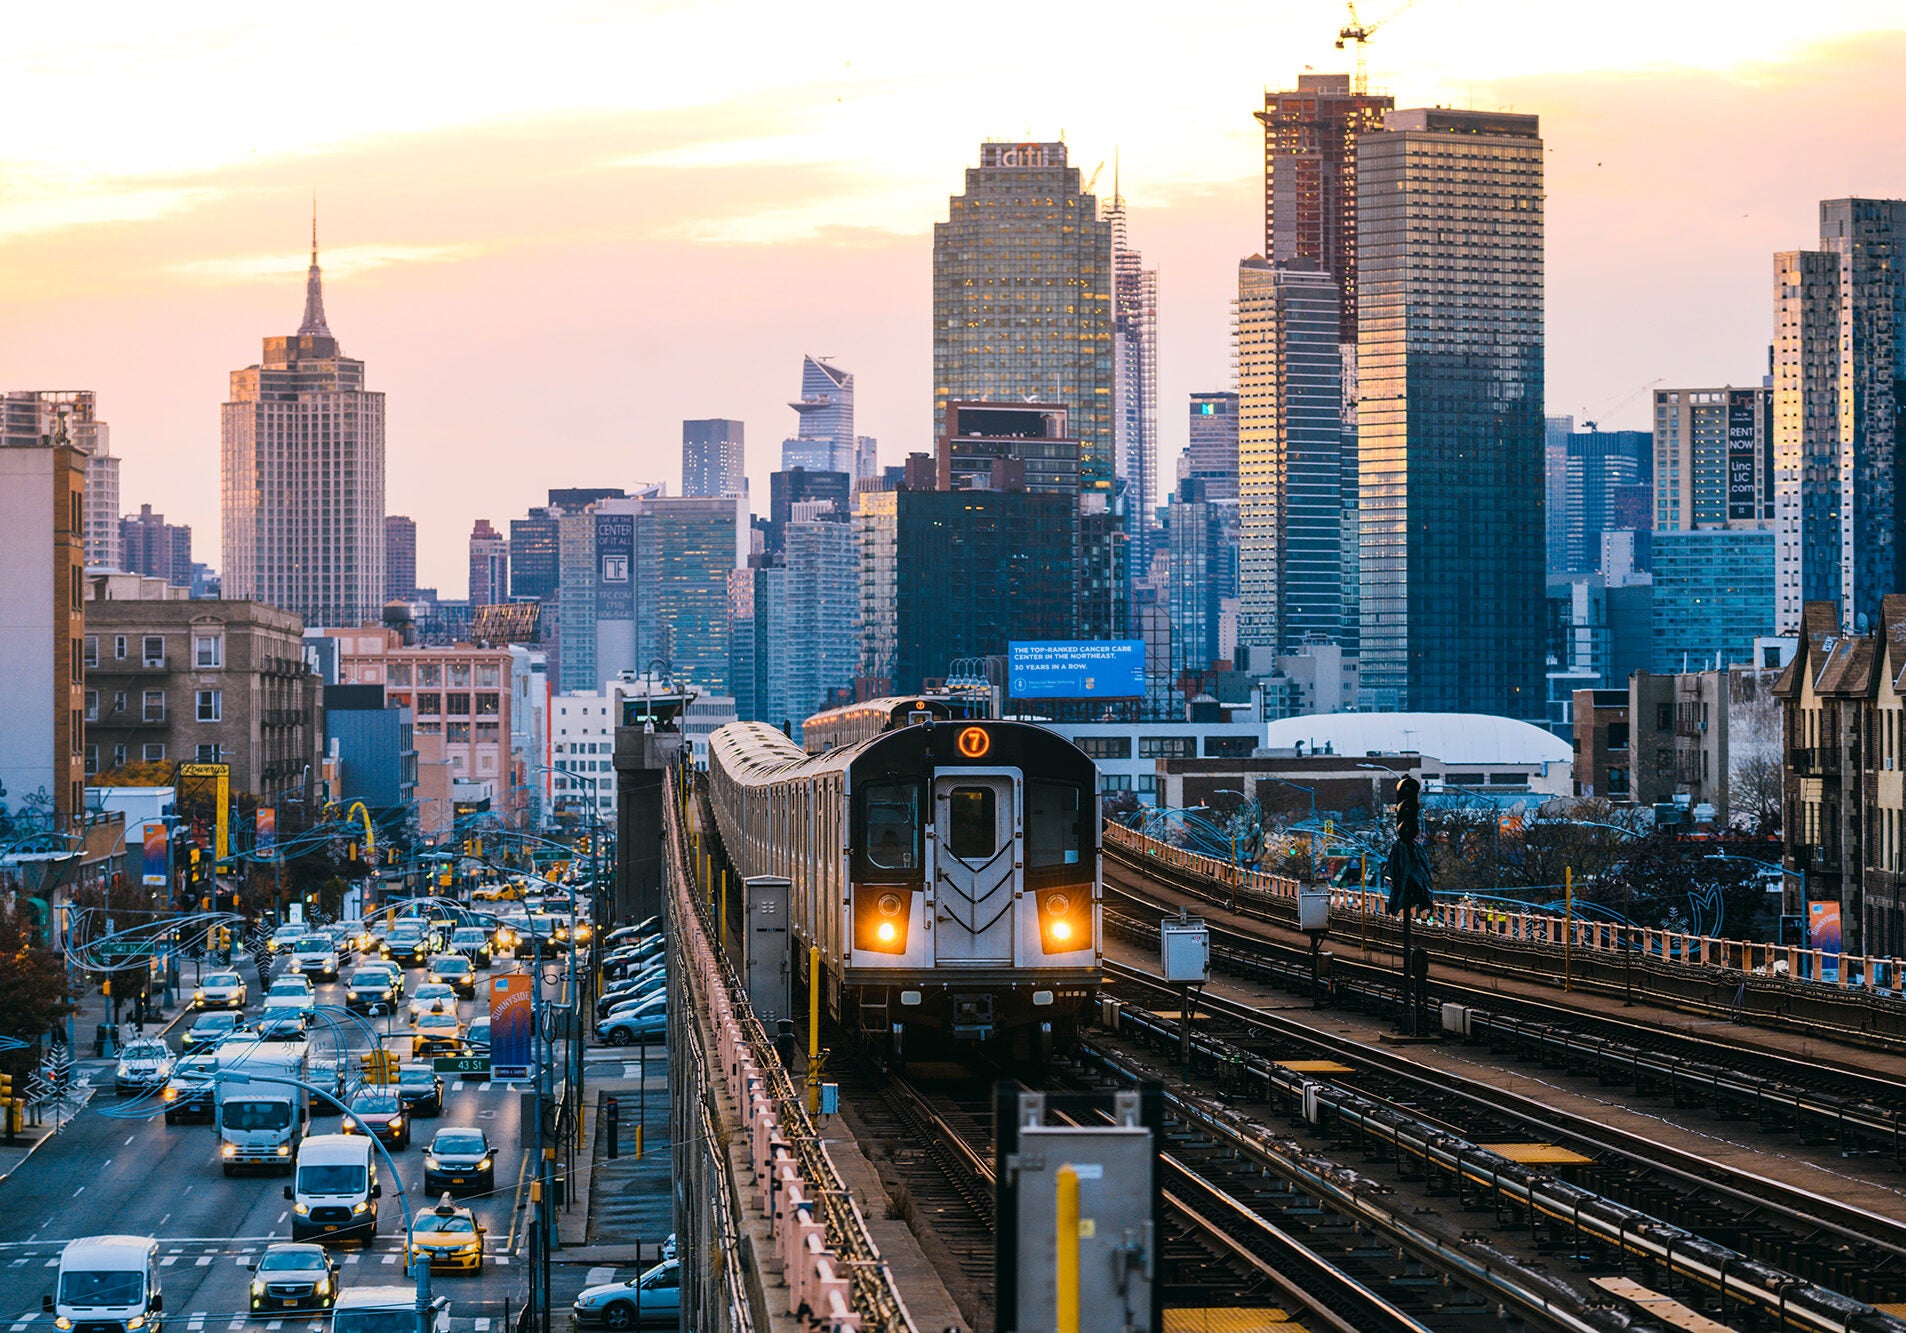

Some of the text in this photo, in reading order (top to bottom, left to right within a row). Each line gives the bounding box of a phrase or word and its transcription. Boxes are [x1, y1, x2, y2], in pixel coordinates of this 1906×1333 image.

[1003, 144, 1041, 167] citi
[1730, 427, 1754, 437] RENT
[1729, 440, 1754, 449] NOW
[1731, 461, 1752, 471] Linc
[1729, 484, 1754, 493] .com
[598, 524, 633, 536] CENTER
[598, 537, 632, 545] OF IT ALL
[491, 991, 530, 1021] SUNNYSIDE
[458, 1061, 482, 1070] 43 St
